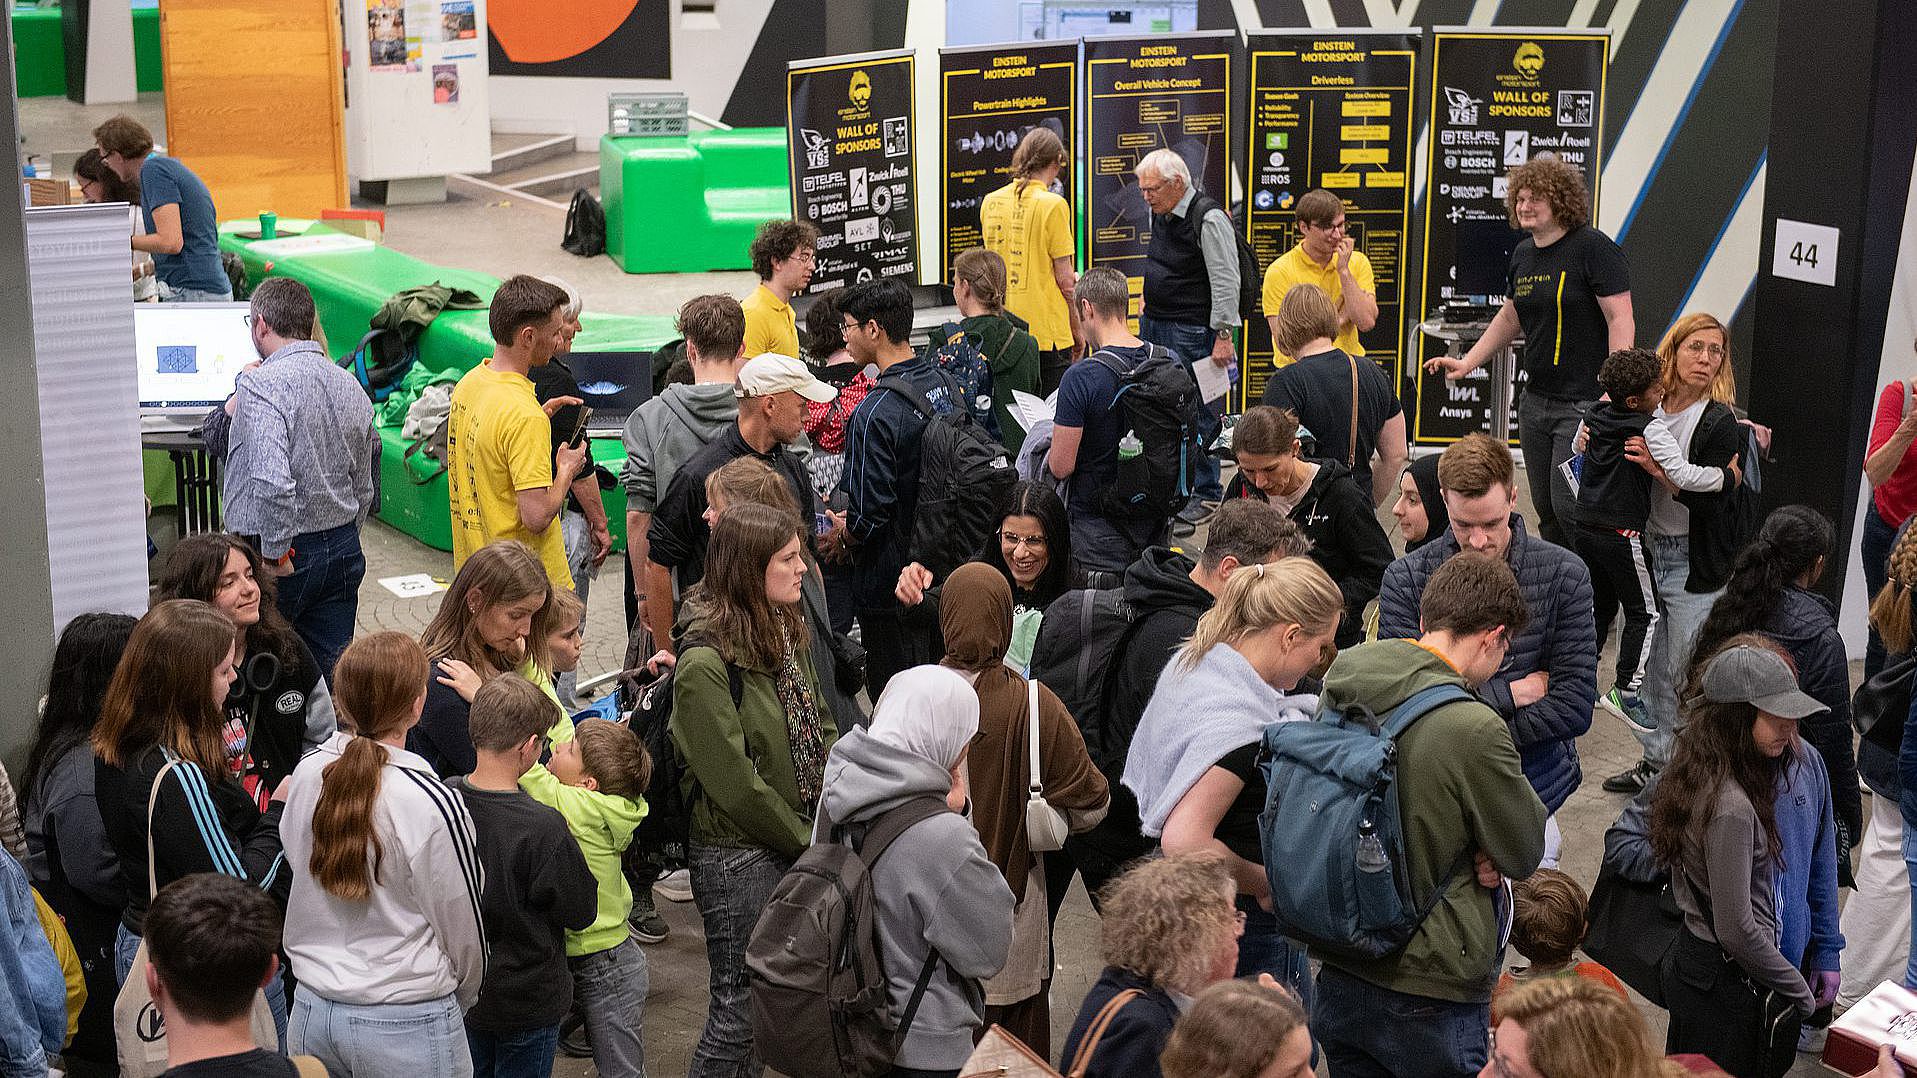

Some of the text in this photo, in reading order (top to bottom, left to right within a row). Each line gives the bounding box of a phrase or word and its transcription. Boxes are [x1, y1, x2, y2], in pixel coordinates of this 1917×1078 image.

[1140, 46, 1177, 56] EINSTEIN
[1313, 41, 1355, 51] EINSTEIN
[993, 55, 1028, 67] EINSTEIN
[1130, 56, 1187, 69] MOTORSPORT
[1301, 52, 1366, 63] MOTORSPORT
[983, 66, 1037, 80] MOTORSPORT
[1115, 78, 1202, 91] Overall Vehicle Concept
[1311, 75, 1355, 85] Driverless
[973, 95, 1047, 111] Powertrain Highlights
[1493, 91, 1551, 103] WALL OF
[1489, 105, 1553, 117] SPONSORS
[836, 122, 879, 139] WALL OF
[1455, 131, 1500, 141] TEUFEL
[835, 137, 881, 155] SPONSORS
[1460, 157, 1497, 168] BOSCH
[815, 171, 846, 185] TEUFEL
[1270, 174, 1291, 185] ROS
[890, 182, 907, 196] THU
[821, 200, 848, 216] BOSCH
[849, 229, 864, 237] AVL
[854, 241, 873, 252] SET
[1789, 241, 1818, 269] 44
[881, 261, 914, 277] SIEMENS
[1449, 386, 1480, 402] IWL
[1439, 406, 1473, 419] Ansys
[280, 694, 302, 709] REAL
